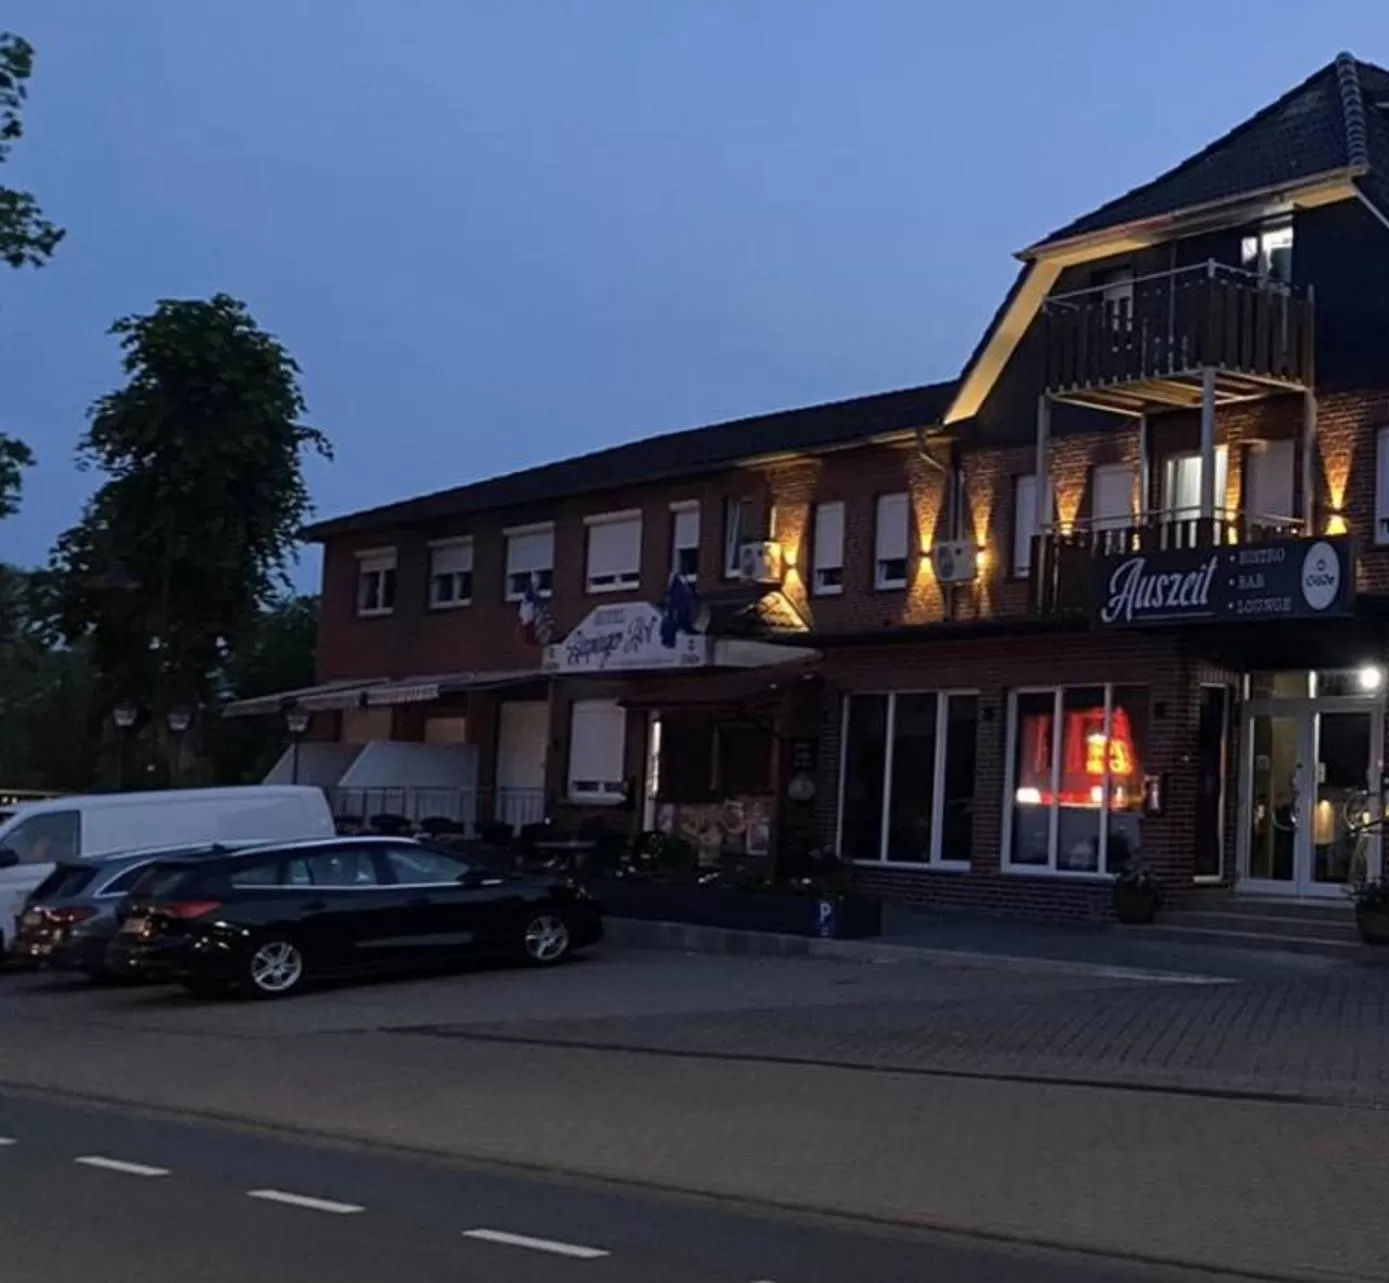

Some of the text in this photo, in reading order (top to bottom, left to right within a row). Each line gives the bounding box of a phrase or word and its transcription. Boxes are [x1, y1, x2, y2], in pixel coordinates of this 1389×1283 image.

[1239, 547, 1286, 566] BISTRO
[1101, 556, 1219, 622] Auszeit
[1237, 576, 1265, 592] BAR
[1237, 596, 1292, 615] LOUNGE
[819, 902, 832, 923] P
